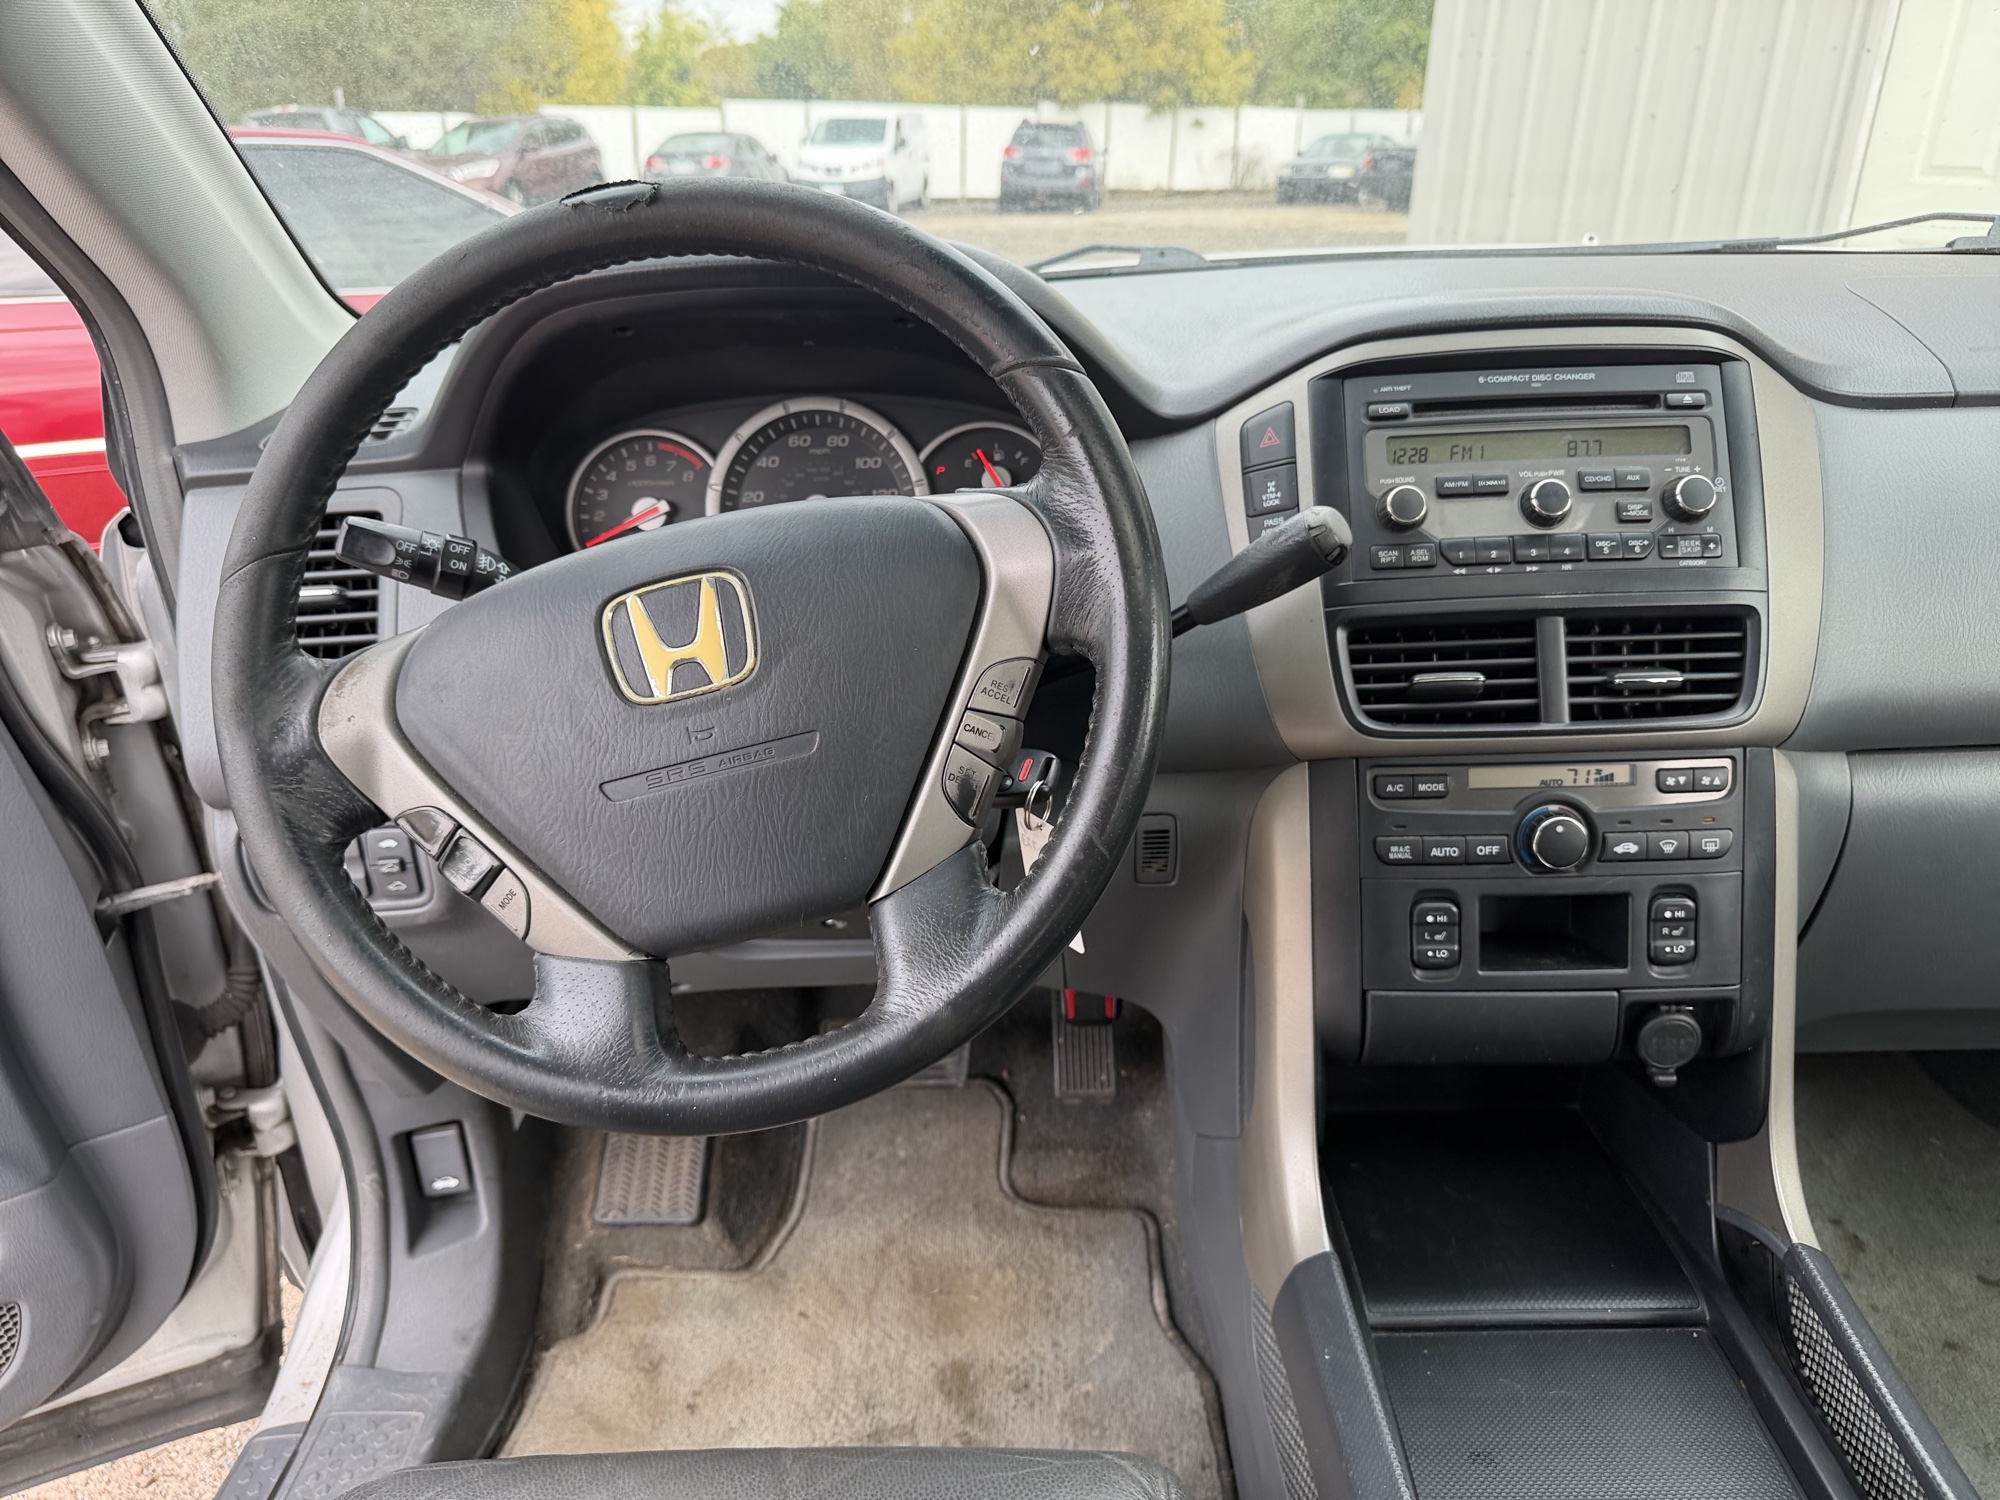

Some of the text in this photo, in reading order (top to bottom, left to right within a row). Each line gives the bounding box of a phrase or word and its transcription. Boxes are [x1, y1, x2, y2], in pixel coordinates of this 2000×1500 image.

[1531, 373, 1552, 382] DISC
[1554, 372, 1596, 381] CHANGER
[1393, 384, 1412, 392] THEFT
[1378, 406, 1401, 414] LOAD
[788, 435, 811, 448] 60
[826, 435, 849, 448] 80
[645, 454, 657, 466] 6
[756, 456, 780, 468] 40
[855, 457, 882, 469] 100
[625, 460, 637, 471] 5
[666, 461, 677, 472] 7
[936, 465, 946, 475] P
[605, 470, 617, 482] 4
[682, 470, 694, 482] 8
[1548, 469, 1565, 477] PWR
[1395, 476, 1415, 484] SOUND
[1444, 480, 1469, 488] AM/FM
[1585, 475, 1612, 483] CD/CHG
[596, 489, 609, 501] 3
[742, 491, 764, 503] 20
[1262, 491, 1281, 500] VTM-4
[1263, 499, 1280, 507] LOCK
[1627, 503, 1643, 511] DISP
[1264, 516, 1284, 527] PASS
[395, 540, 417, 554] OFF
[1680, 539, 1701, 547] SEEK
[450, 544, 471, 556] OFF
[1378, 550, 1399, 558] SCAN
[1681, 546, 1701, 554] SKIP
[1380, 556, 1397, 564] RPT
[450, 560, 467, 571] ON
[990, 679, 1010, 694] RES
[980, 687, 1012, 705] ACCEL
[645, 747, 776, 787] SRS AIRBAG
[1567, 768, 1591, 785] 71
[1418, 783, 1445, 792] MODE
[1539, 778, 1564, 787] AUTO
[1386, 783, 1404, 793] A/C
[1431, 847, 1459, 857] AUTO
[1476, 845, 1500, 856] OFF
[1388, 852, 1413, 860] MANUAL
[498, 888, 517, 910] MODE
[1436, 914, 1448, 923] HI
[1674, 910, 1686, 918] HI
[1435, 949, 1449, 958] LO
[1673, 944, 1686, 954] LO
